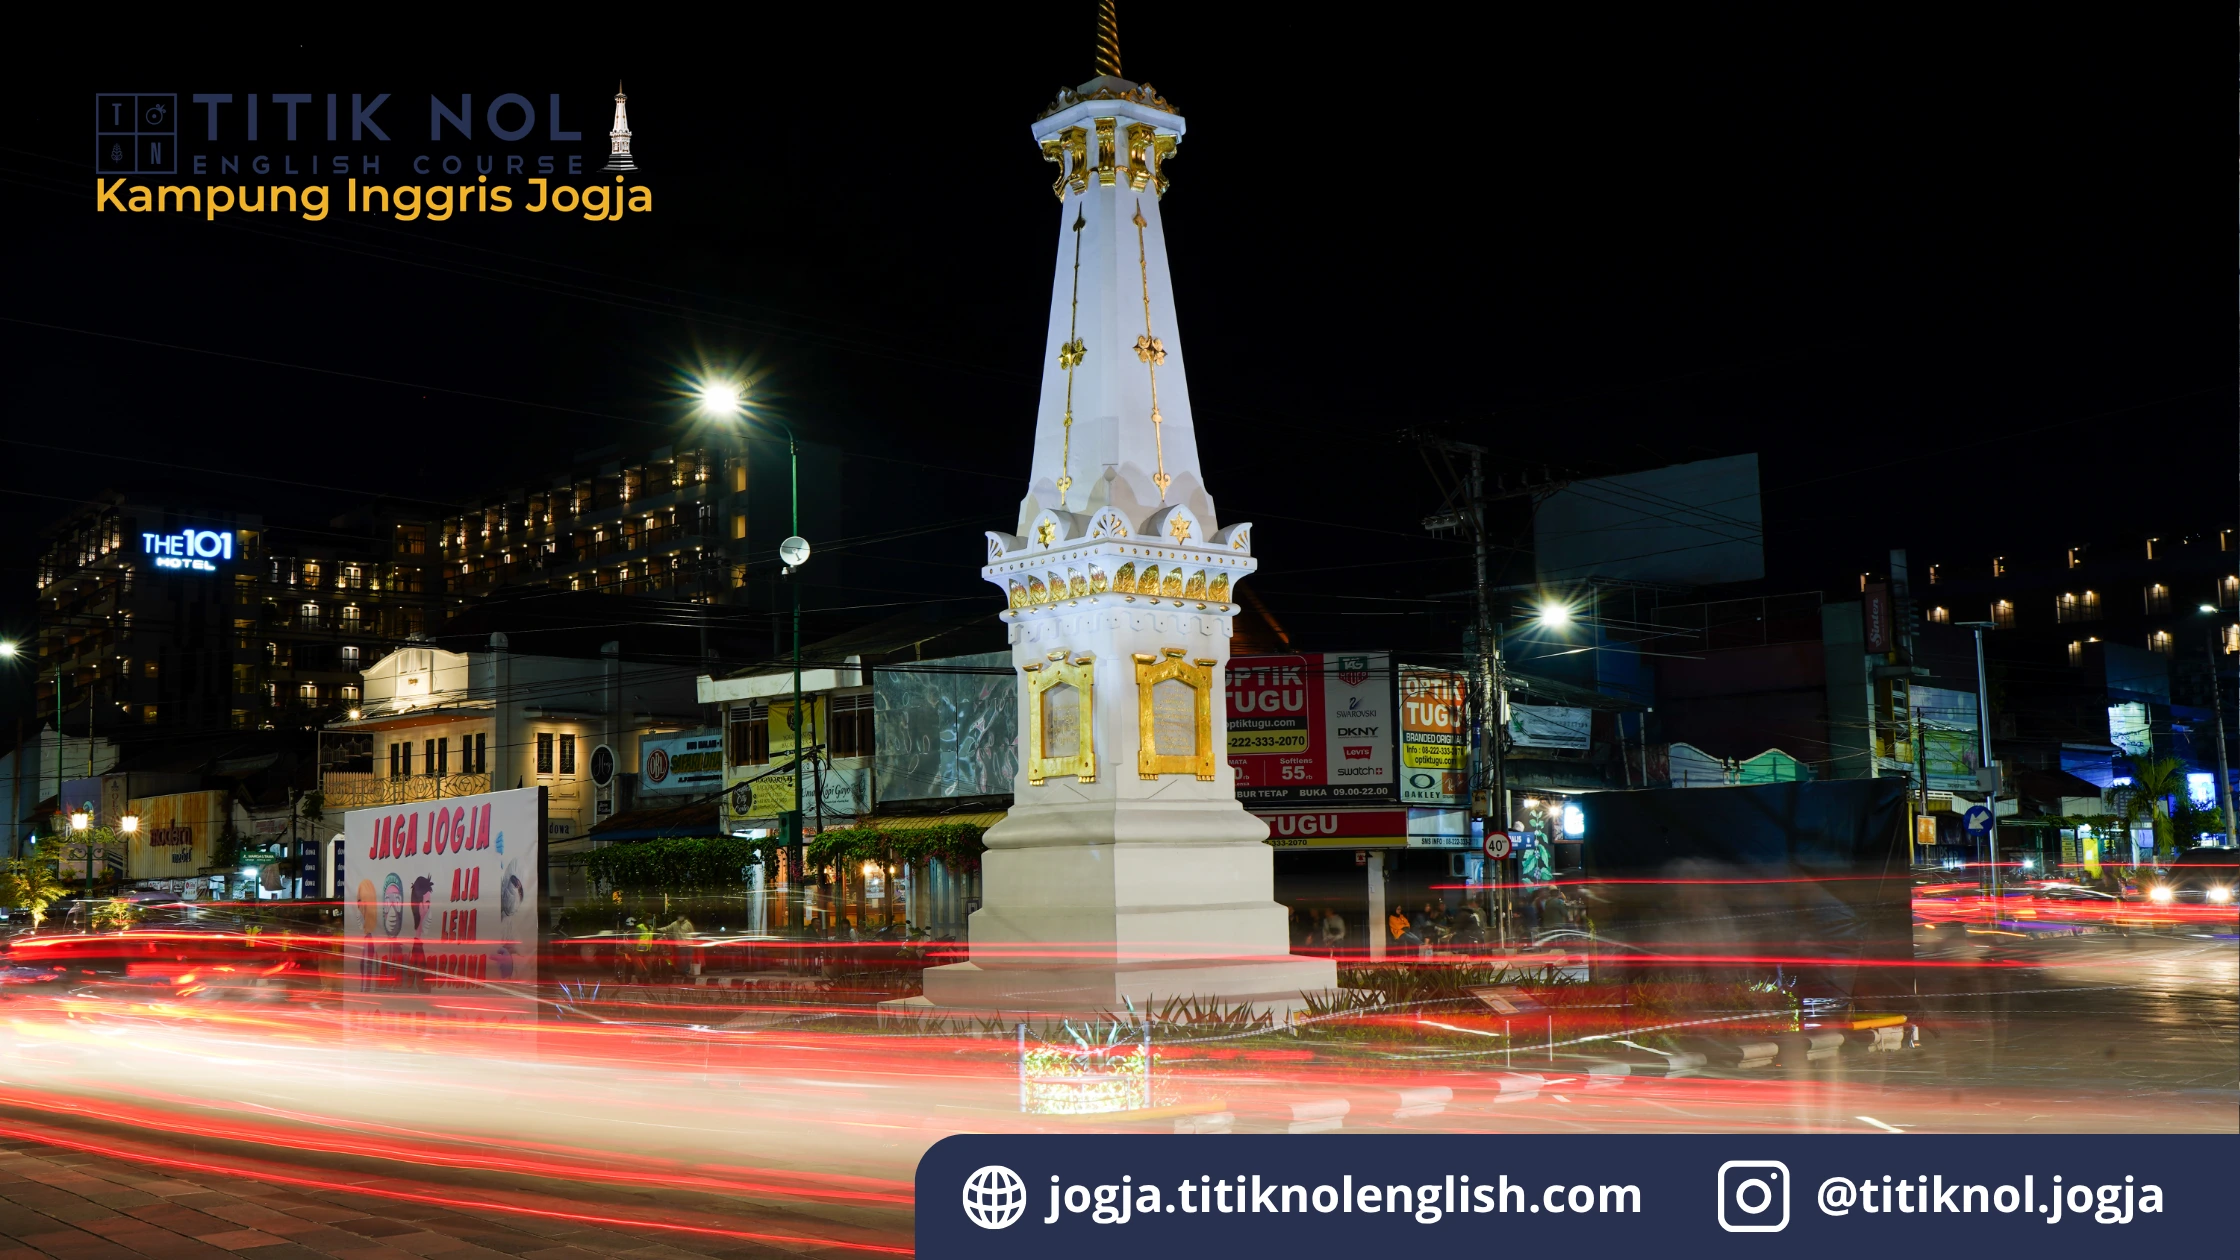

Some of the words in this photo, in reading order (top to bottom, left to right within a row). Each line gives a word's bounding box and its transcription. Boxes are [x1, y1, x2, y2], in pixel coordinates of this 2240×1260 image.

[142, 533, 184, 556] THE
[183, 529, 232, 560] 101
[155, 556, 216, 571] HOTEL
[1406, 676, 1462, 700] OPTIK
[1336, 710, 1377, 718] SWAROVSKI
[1406, 702, 1461, 727] TUGU
[1337, 726, 1379, 736] DKNY
[1406, 732, 1435, 743] BRANDED
[1406, 746, 1418, 754] Info
[1280, 757, 1313, 765] Softlens
[1415, 757, 1457, 767] optiktugu.com
[1337, 766, 1375, 777] swatch
[1258, 789, 1289, 798] TETAP
[1299, 788, 1328, 798] BUKA
[1333, 786, 1389, 796] 09.00-22.00
[1404, 791, 1441, 799] OAKLEY
[369, 811, 419, 861] JAGA
[422, 802, 492, 856] JOGJA
[1488, 840, 1503, 852] 40
[450, 866, 480, 903] AJA
